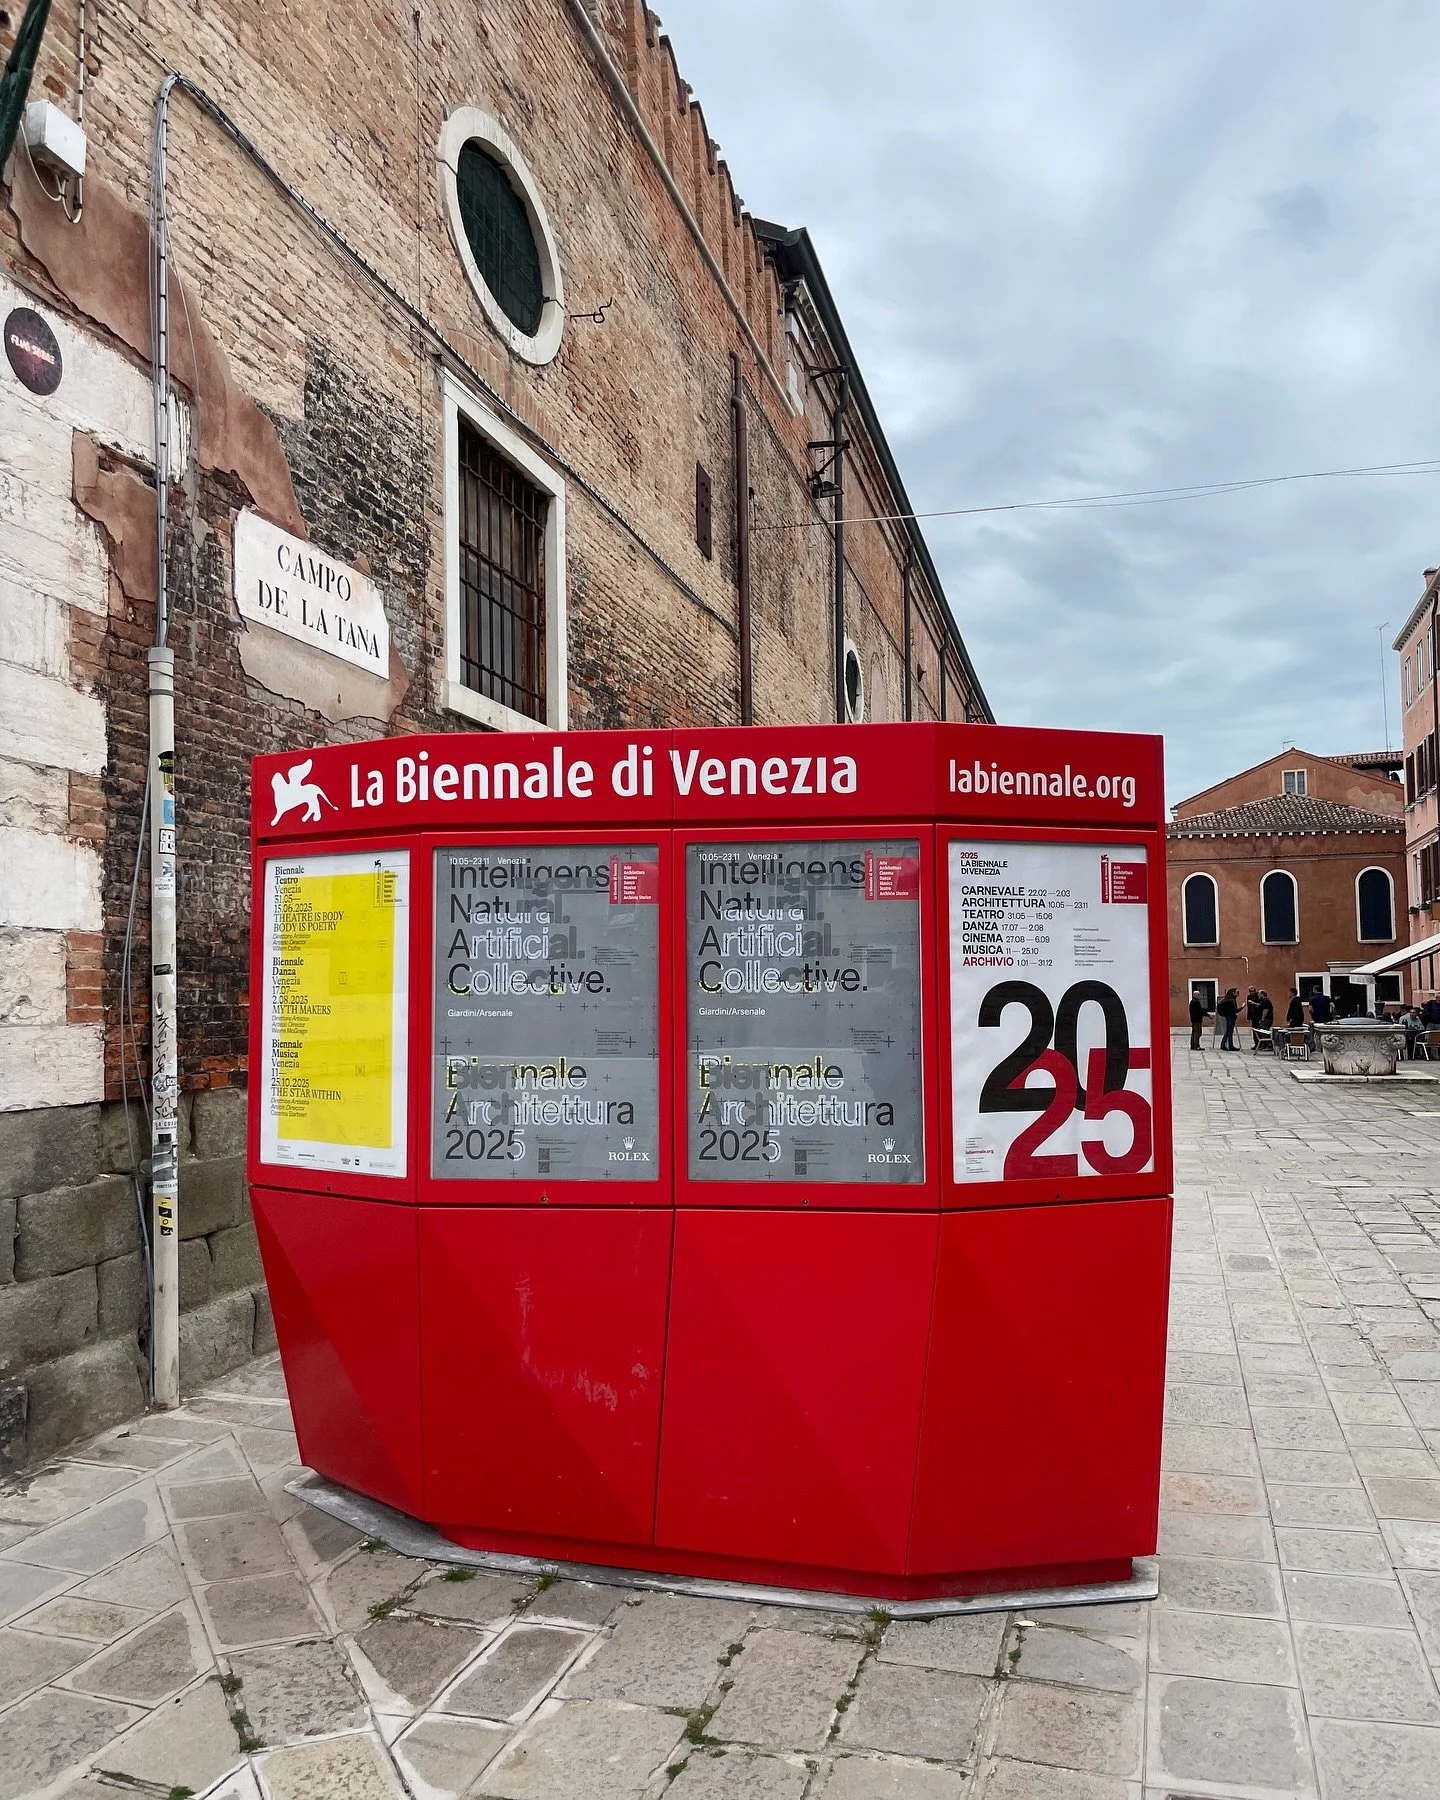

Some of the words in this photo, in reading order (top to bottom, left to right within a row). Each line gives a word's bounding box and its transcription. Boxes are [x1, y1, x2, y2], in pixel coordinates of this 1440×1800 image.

[278, 544, 351, 602] CAMPO
[258, 578, 289, 618] DE
[302, 598, 329, 636] LA
[334, 614, 380, 658] TANA
[351, 764, 384, 808] La
[396, 746, 594, 804] Biennale
[612, 744, 654, 797] di
[668, 749, 858, 796] Venezia
[949, 759, 1136, 808] labiennale.org
[497, 857, 526, 865] Venezia
[748, 852, 778, 860] Venezia
[960, 852, 978, 860] 2025
[972, 860, 1008, 868] BIENNALE
[275, 865, 304, 876] Biennale
[970, 868, 1000, 876] VENEZIA
[275, 876, 298, 885] Teatro
[274, 885, 302, 894] Venezia
[962, 886, 1025, 896] CARNEVALE
[274, 903, 312, 913] 15.06.2025
[962, 898, 1046, 908] ARCHITETTURA
[274, 912, 312, 922] THEATRE
[314, 912, 321, 920] IS
[322, 911, 344, 920] BODY
[962, 910, 1004, 919] TEATRO
[274, 922, 298, 932] BODY
[299, 922, 306, 932] IS
[308, 921, 338, 932] POETRY
[962, 922, 998, 930] DANZA
[962, 933, 1004, 942] CINEMA
[962, 945, 1004, 954] MUSICA
[272, 957, 304, 966] Biennale
[962, 957, 1014, 966] ARCHIVIO
[272, 967, 296, 976] Danza
[272, 976, 300, 986] Venezia
[448, 962, 611, 996] Collective.
[699, 960, 868, 994] Collective.
[272, 995, 308, 1004] 2.08.2025
[272, 1005, 298, 1014] MYTH
[300, 1005, 332, 1015] MAKERS
[448, 1009, 513, 1018] Giardini/Arsenale
[698, 1008, 766, 1016] Giardini/Arsenale
[272, 1038, 302, 1049] Biennale
[272, 1049, 298, 1058] Musica
[272, 1058, 300, 1068] Venezia
[446, 1056, 588, 1090] Biennale
[700, 1055, 845, 1090] Biennale
[272, 1078, 310, 1088] 25.10.2025
[271, 1088, 288, 1097] THE
[290, 1088, 310, 1098] STAR
[312, 1089, 342, 1100] WITHIN
[445, 1092, 634, 1126] Architettura
[698, 1092, 894, 1126] Architettura
[445, 1129, 526, 1161] 2025
[698, 1129, 782, 1162] 2025
[608, 1152, 650, 1161] ROLEX
[868, 1154, 912, 1163] ROLEX
